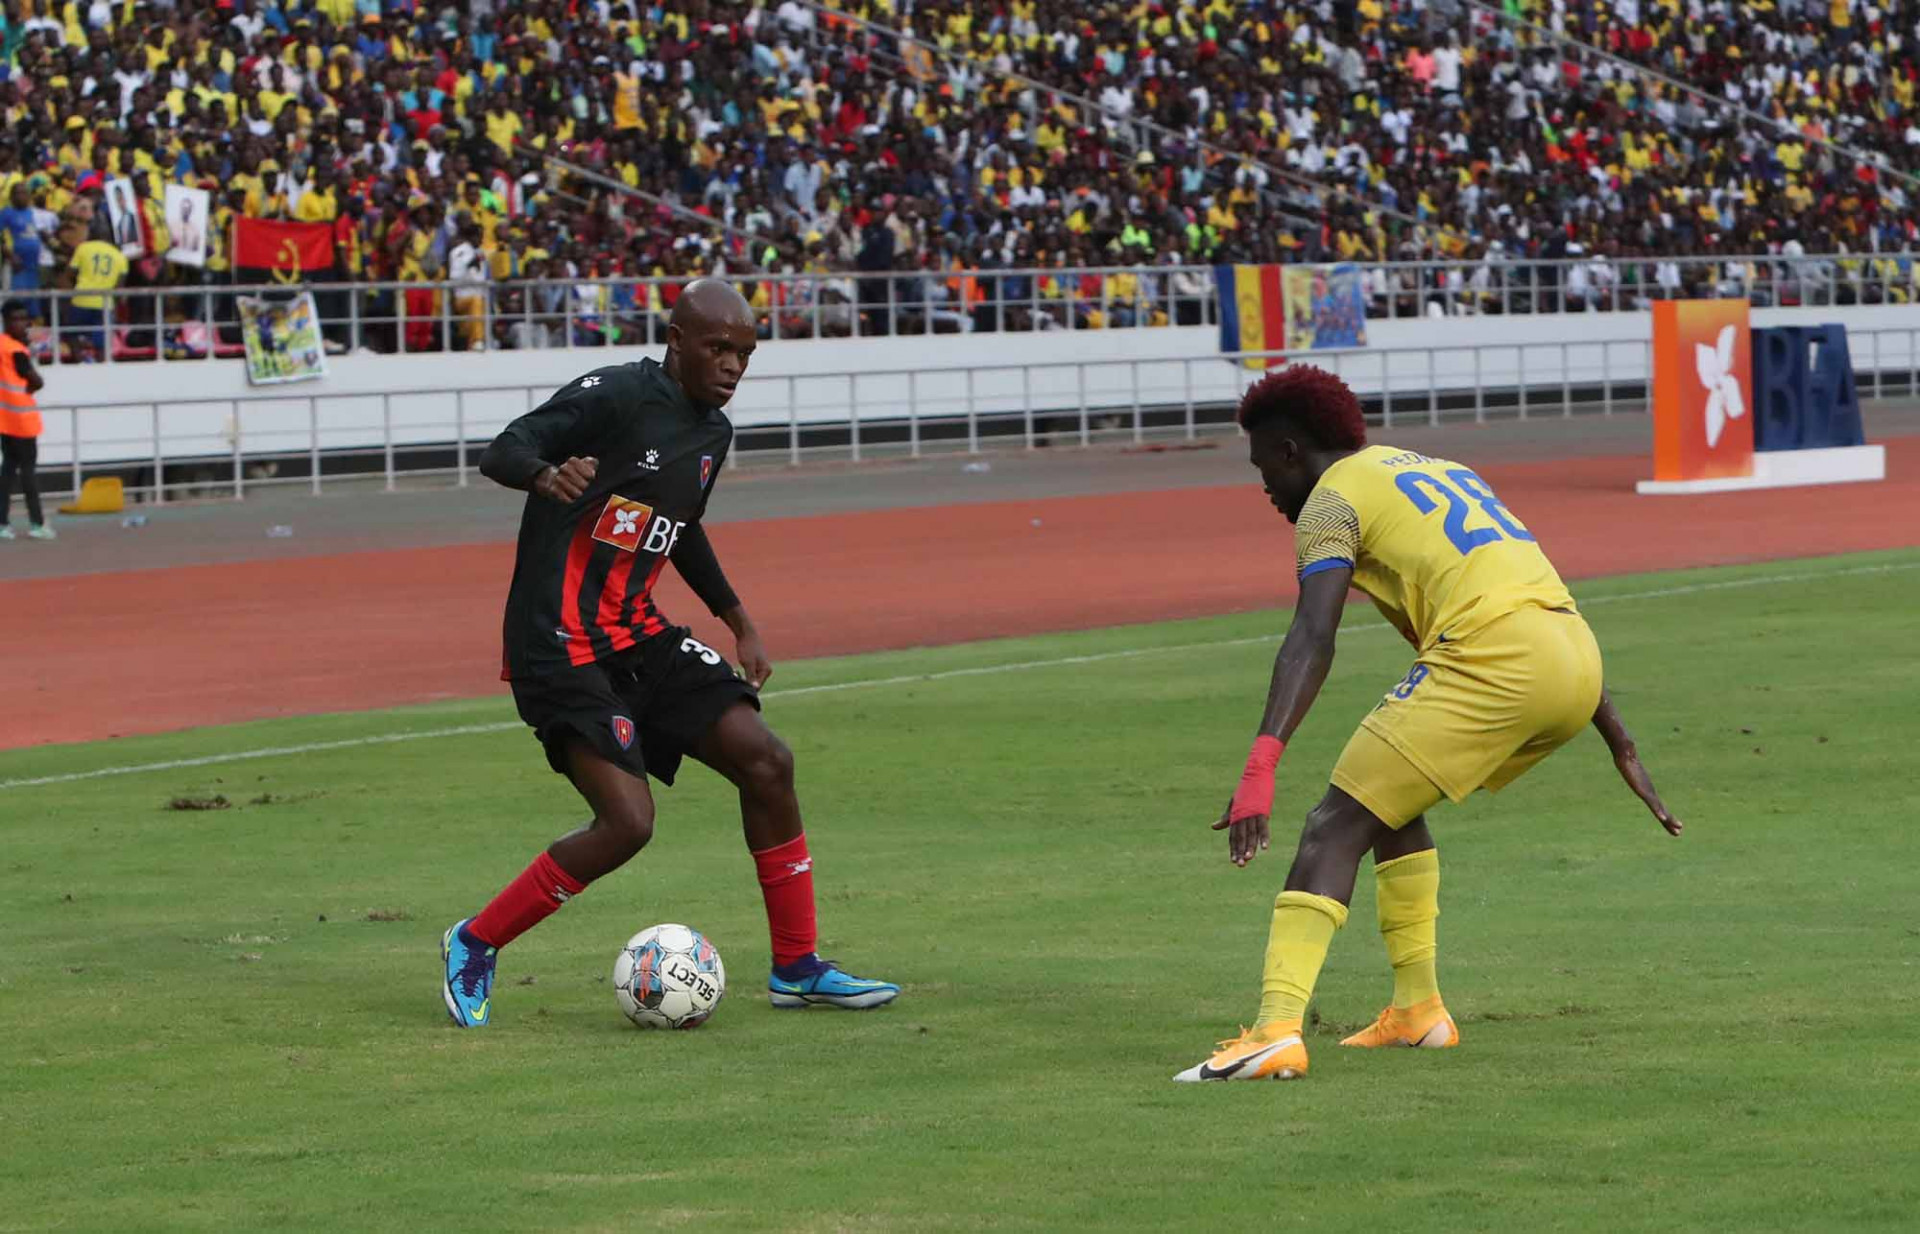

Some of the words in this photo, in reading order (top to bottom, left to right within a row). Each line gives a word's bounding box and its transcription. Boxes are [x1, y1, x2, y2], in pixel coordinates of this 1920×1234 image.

[1395, 469, 1536, 556] 28
[680, 637, 721, 665] 3
[668, 962, 716, 1002] SELECT
